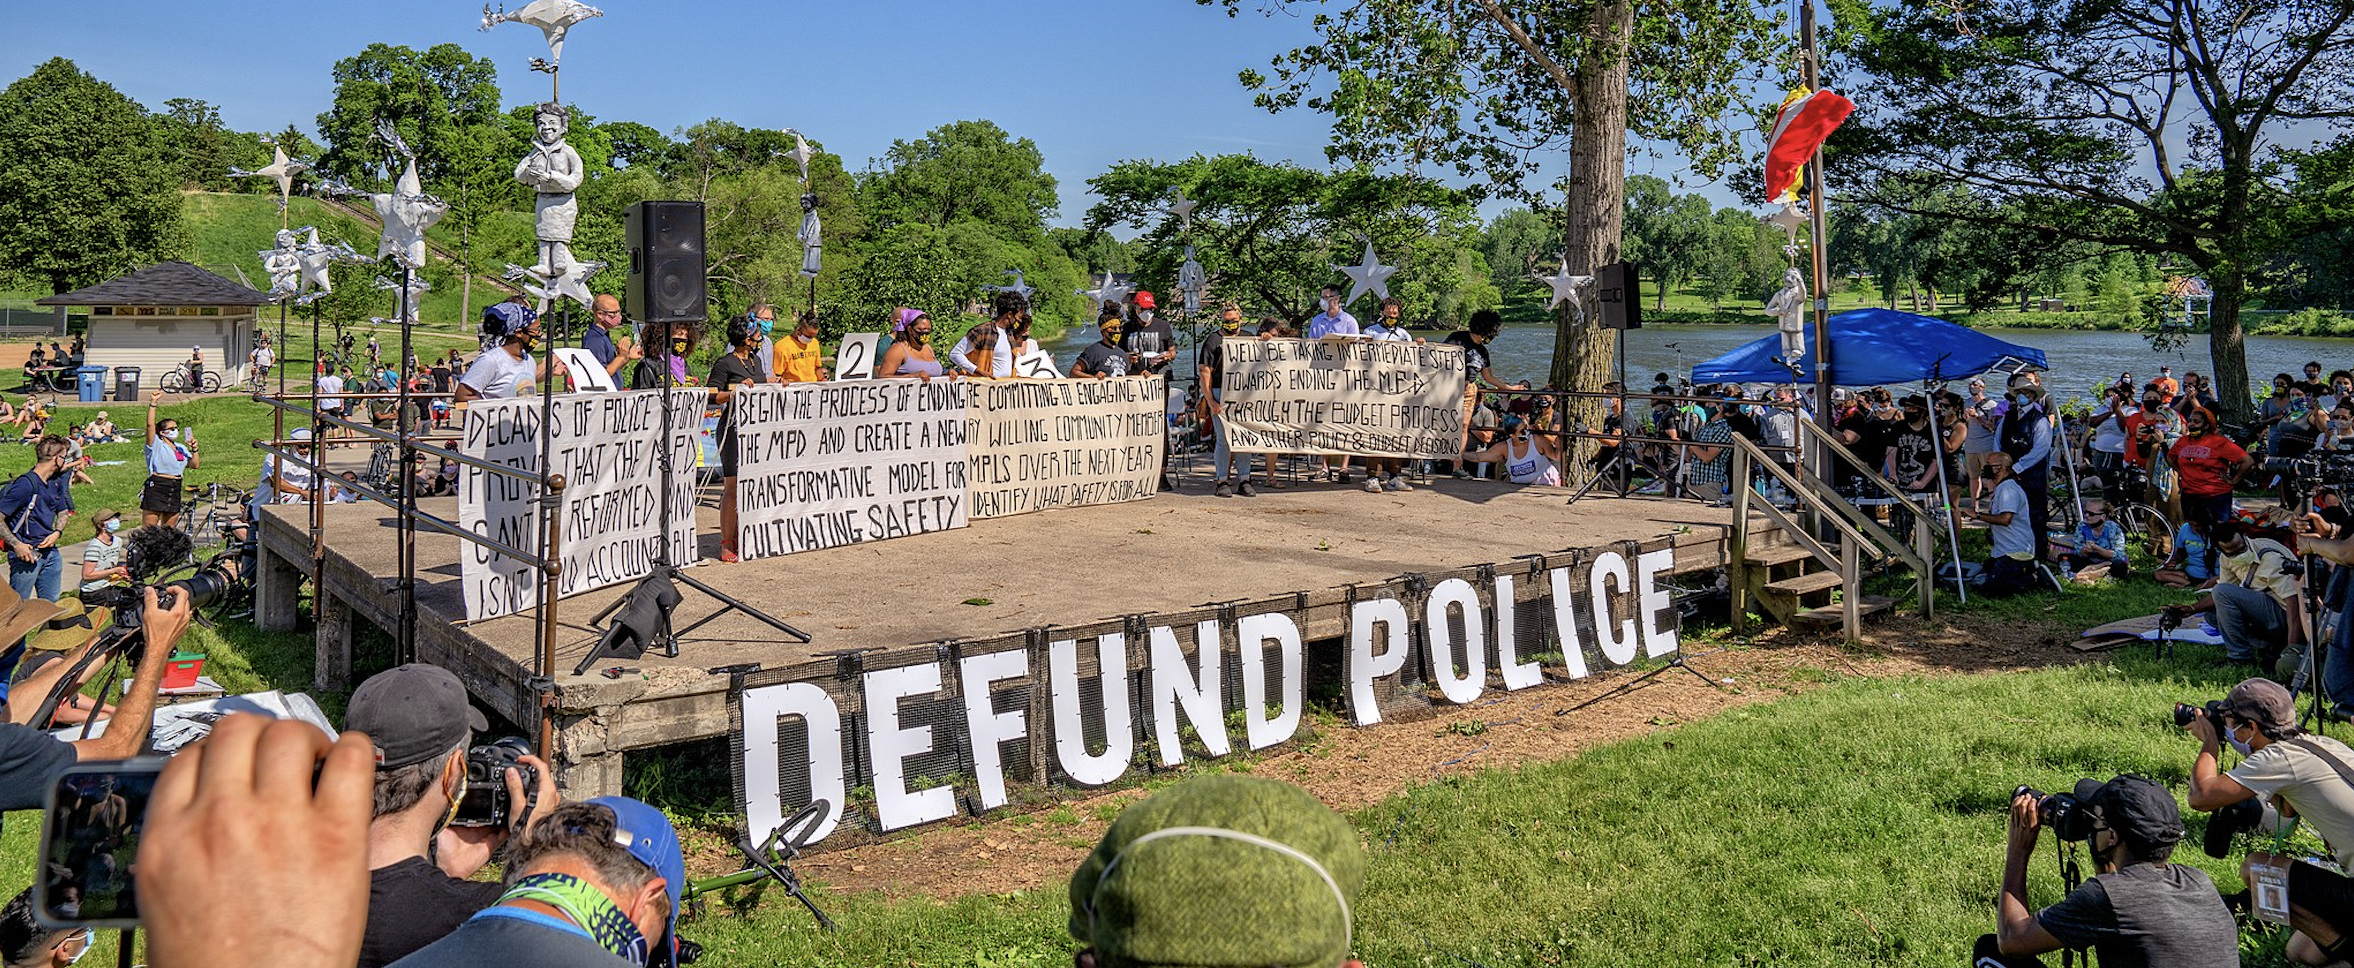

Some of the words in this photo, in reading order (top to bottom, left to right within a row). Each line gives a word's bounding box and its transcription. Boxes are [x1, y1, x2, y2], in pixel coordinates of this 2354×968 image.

[570, 352, 608, 392] 1
[840, 341, 868, 380] 2
[1020, 356, 1057, 379] 3
[1266, 342, 1287, 362] BE
[1290, 342, 1333, 362] TAKING
[1336, 341, 1426, 367] INTERMEDIATE
[1429, 349, 1464, 372] STEPS
[988, 382, 1059, 411] COMMITTING
[1058, 383, 1073, 406] TO
[1076, 379, 1137, 405] ENGAGING
[1139, 378, 1164, 402] WITH
[1226, 369, 1282, 391] TOWARDS
[1289, 369, 1336, 390] ENDING
[1343, 369, 1370, 392] THE
[468, 401, 561, 449] DECADS
[574, 401, 593, 437] OF
[603, 395, 653, 433] POLICE
[659, 391, 707, 431] EFORM
[739, 390, 787, 427] BEGIN
[793, 389, 814, 420] THE
[819, 384, 890, 419] PROCESS
[897, 382, 914, 412] OF
[918, 382, 966, 412] ENDING
[1224, 400, 1290, 425] THROUGH
[1294, 399, 1324, 424] THE
[1331, 401, 1384, 427] BUDGET
[1391, 404, 1460, 433] PROCESS
[738, 433, 761, 467] THE
[818, 426, 845, 455] AND
[855, 421, 912, 453] CREATE
[920, 422, 930, 448] A
[937, 419, 966, 448] NEW
[989, 419, 1048, 448] WILLING
[1056, 413, 1123, 442] COMMUNITY
[1126, 410, 1163, 438] MEMBER
[1231, 428, 1258, 447] AND
[1260, 429, 1305, 448] OTHER
[1308, 431, 1348, 450] POLICY
[1352, 431, 1365, 451] &
[1369, 433, 1412, 453] BUDGET
[469, 453, 543, 504] PROV
[561, 443, 606, 488] THAT
[615, 440, 643, 482] THE
[1019, 451, 1060, 482] OVER
[1063, 449, 1083, 476] THE
[1089, 448, 1117, 476] NEXT
[1118, 445, 1154, 474] YEAR
[740, 465, 875, 513] TRANSFORMATIVE
[889, 461, 939, 495] MODEL
[945, 460, 966, 489] FOR
[972, 486, 1030, 517] IDENTIFY
[1033, 482, 1068, 511] WHAT
[1067, 480, 1108, 506] SAFETY
[1107, 481, 1118, 502] IS
[1118, 480, 1134, 501] FOR
[1133, 475, 1155, 499] ALL
[569, 484, 655, 542] REFORMED
[742, 509, 864, 561] CULTIVATING
[868, 494, 961, 540] SAFETY
[587, 527, 698, 588] ACCOUNTBLE
[742, 612, 1303, 849] DEFUND
[1350, 548, 1679, 727] POLICE
